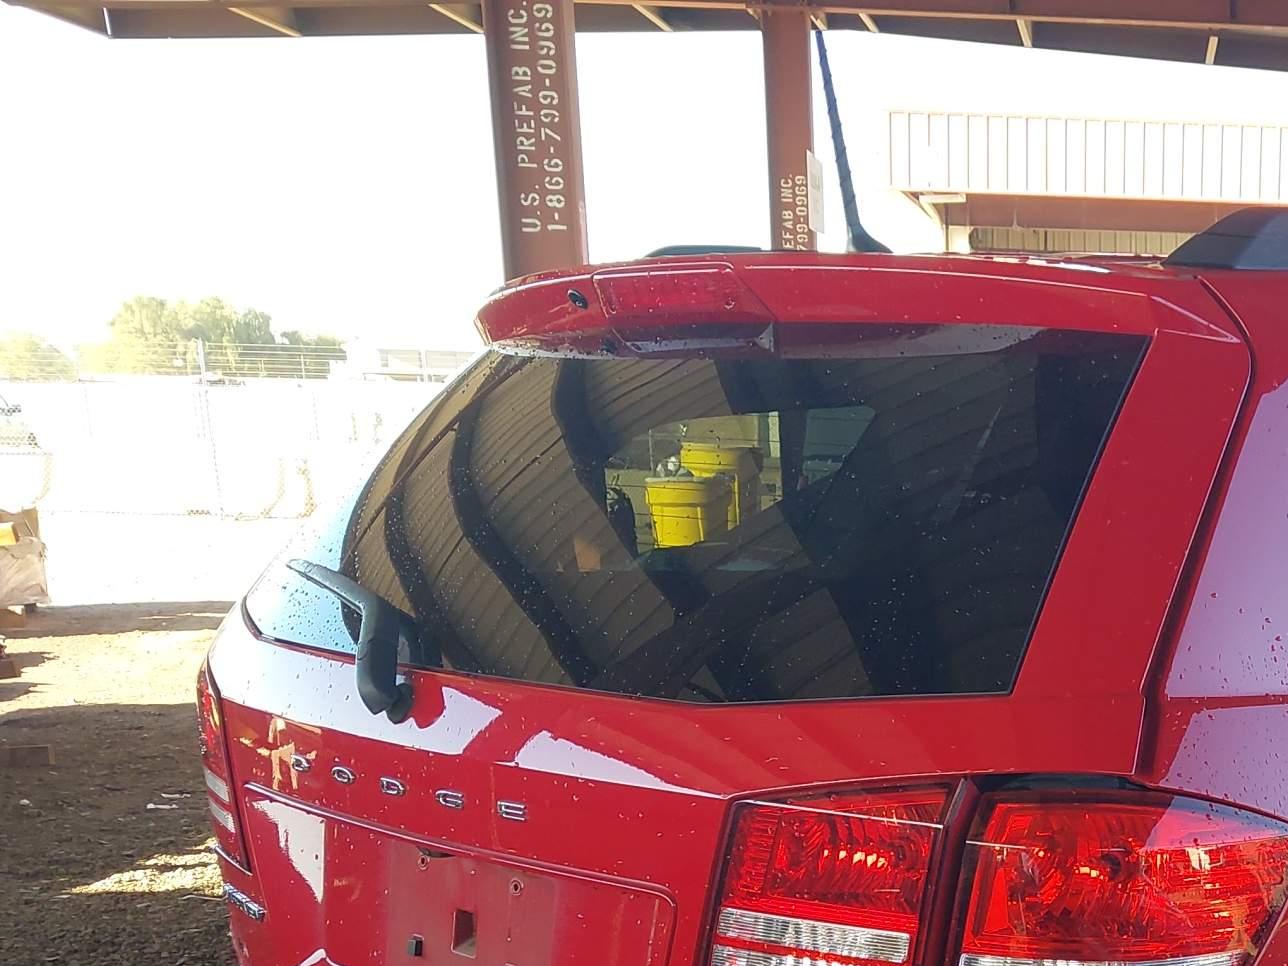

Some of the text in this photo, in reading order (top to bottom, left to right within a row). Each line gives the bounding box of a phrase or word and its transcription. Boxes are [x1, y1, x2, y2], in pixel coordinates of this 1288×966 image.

[508, 1, 541, 232] U.S. PREFAB INC.
[533, 3, 567, 231] 1-866-799-0969
[781, 173, 795, 249] EFAB INC.
[795, 175, 808, 250] 799-0969
[290, 753, 527, 821] DODGE
